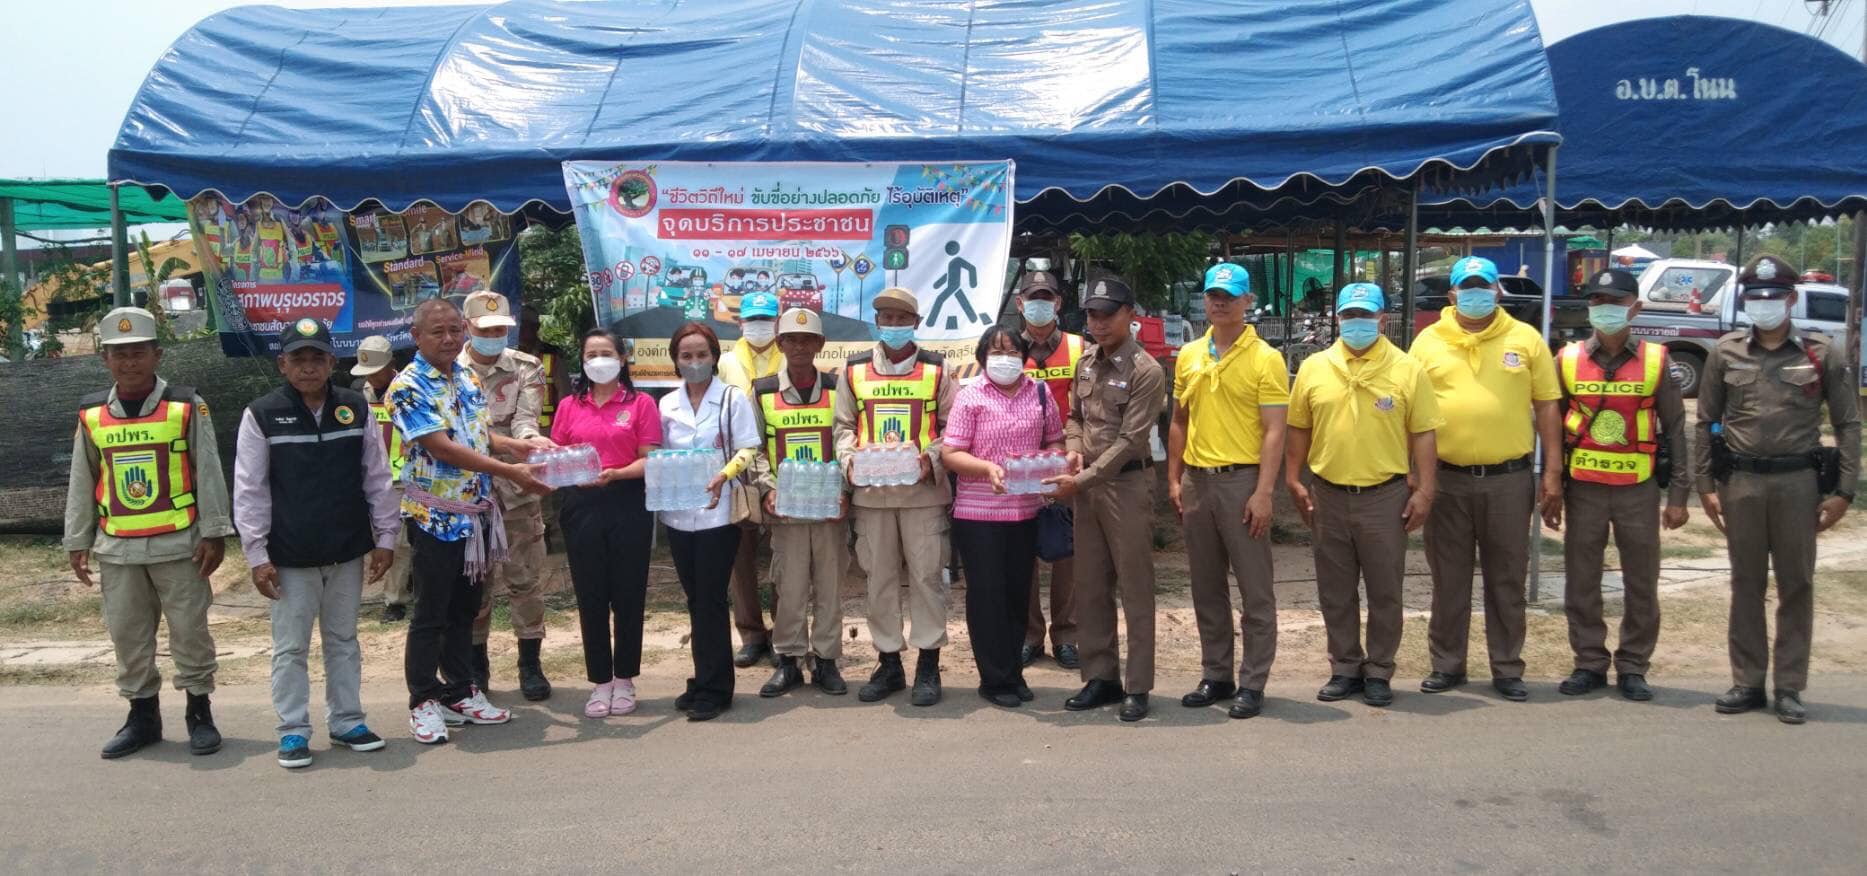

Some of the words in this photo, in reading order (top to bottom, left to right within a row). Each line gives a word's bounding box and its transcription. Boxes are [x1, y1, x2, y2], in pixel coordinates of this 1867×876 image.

[751, 182, 881, 205] ขับขี่อย่างปลอดภัย
[661, 212, 871, 237] จุดบริการประชาชน
[752, 247, 800, 258] เมษายน
[383, 256, 425, 273] Standard
[872, 383, 914, 396] อปพร.
[1574, 383, 1645, 394] POLICE
[782, 412, 823, 425] อปพร.
[106, 427, 155, 443] อปพร.
[1575, 452, 1638, 470] ตำรวจ
